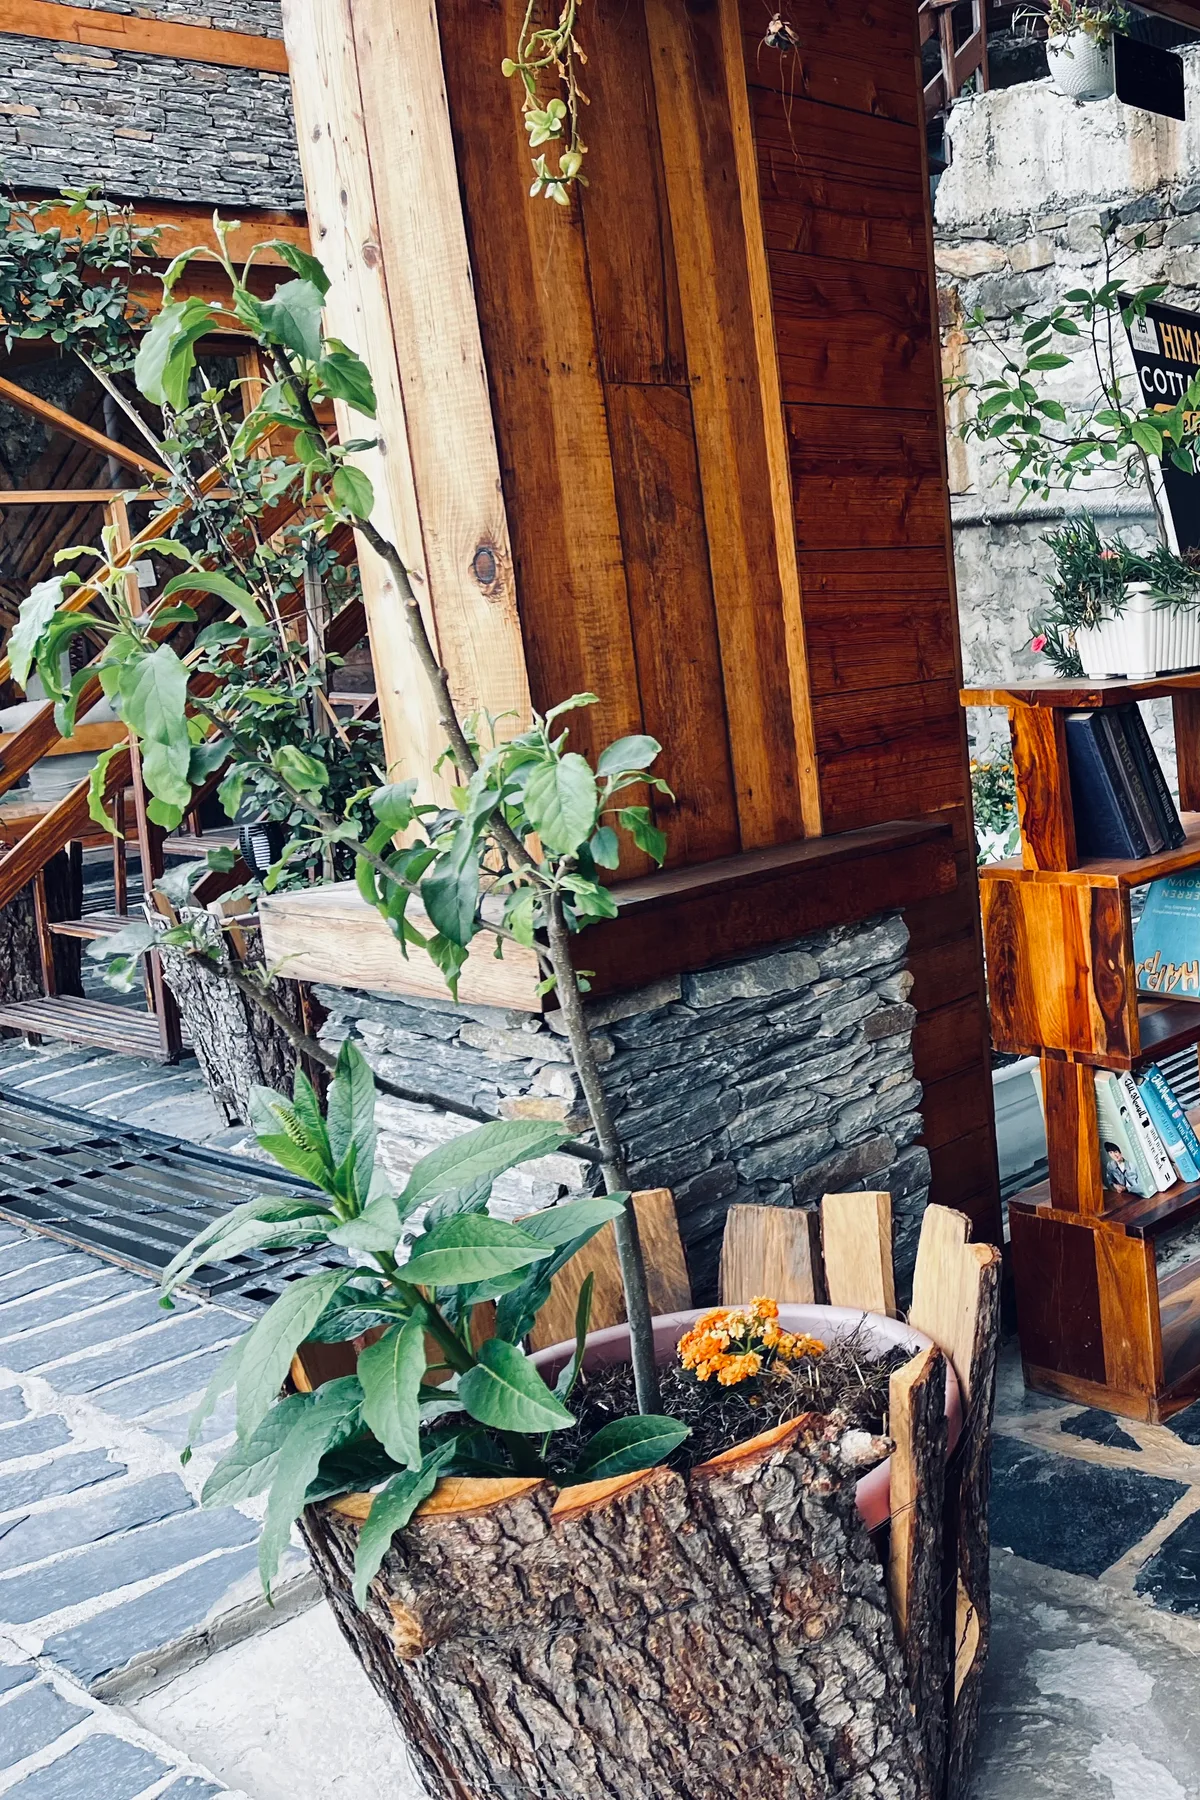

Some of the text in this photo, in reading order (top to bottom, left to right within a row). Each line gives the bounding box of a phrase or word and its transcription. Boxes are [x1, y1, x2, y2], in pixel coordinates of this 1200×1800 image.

[1117, 733, 1133, 773] Third
[1132, 774, 1153, 821] degree
[1152, 768, 1164, 795] CHRIS
[1160, 791, 1175, 824] JERICHO
[1150, 1128, 1160, 1142] and
[1187, 1140, 1200, 1157] back
[1153, 1153, 1164, 1171] back
